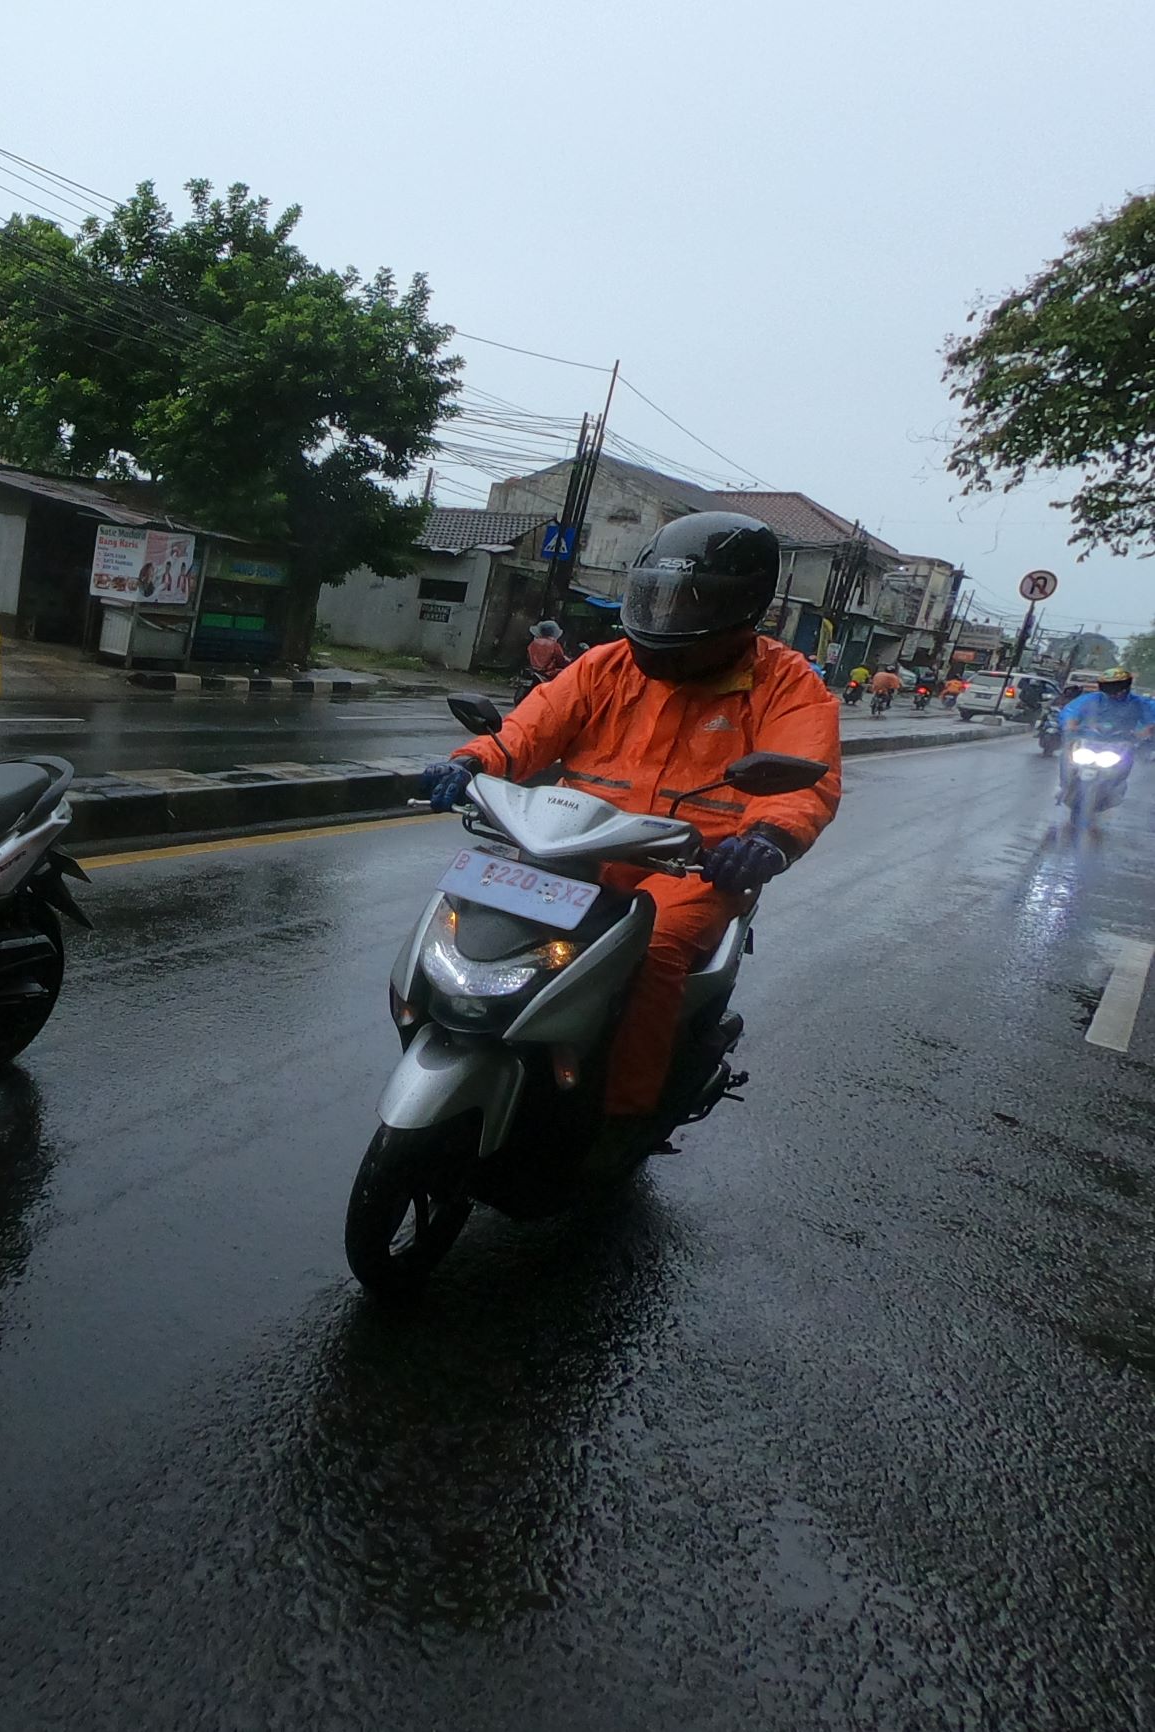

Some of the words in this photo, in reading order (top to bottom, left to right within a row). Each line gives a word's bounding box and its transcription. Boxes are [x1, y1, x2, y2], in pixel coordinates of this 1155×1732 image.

[658, 557, 696, 569] RSV
[547, 796, 579, 811] YAMAHA
[455, 853, 470, 870] B
[481, 862, 538, 890] 6220
[549, 881, 593, 907] SXZ
